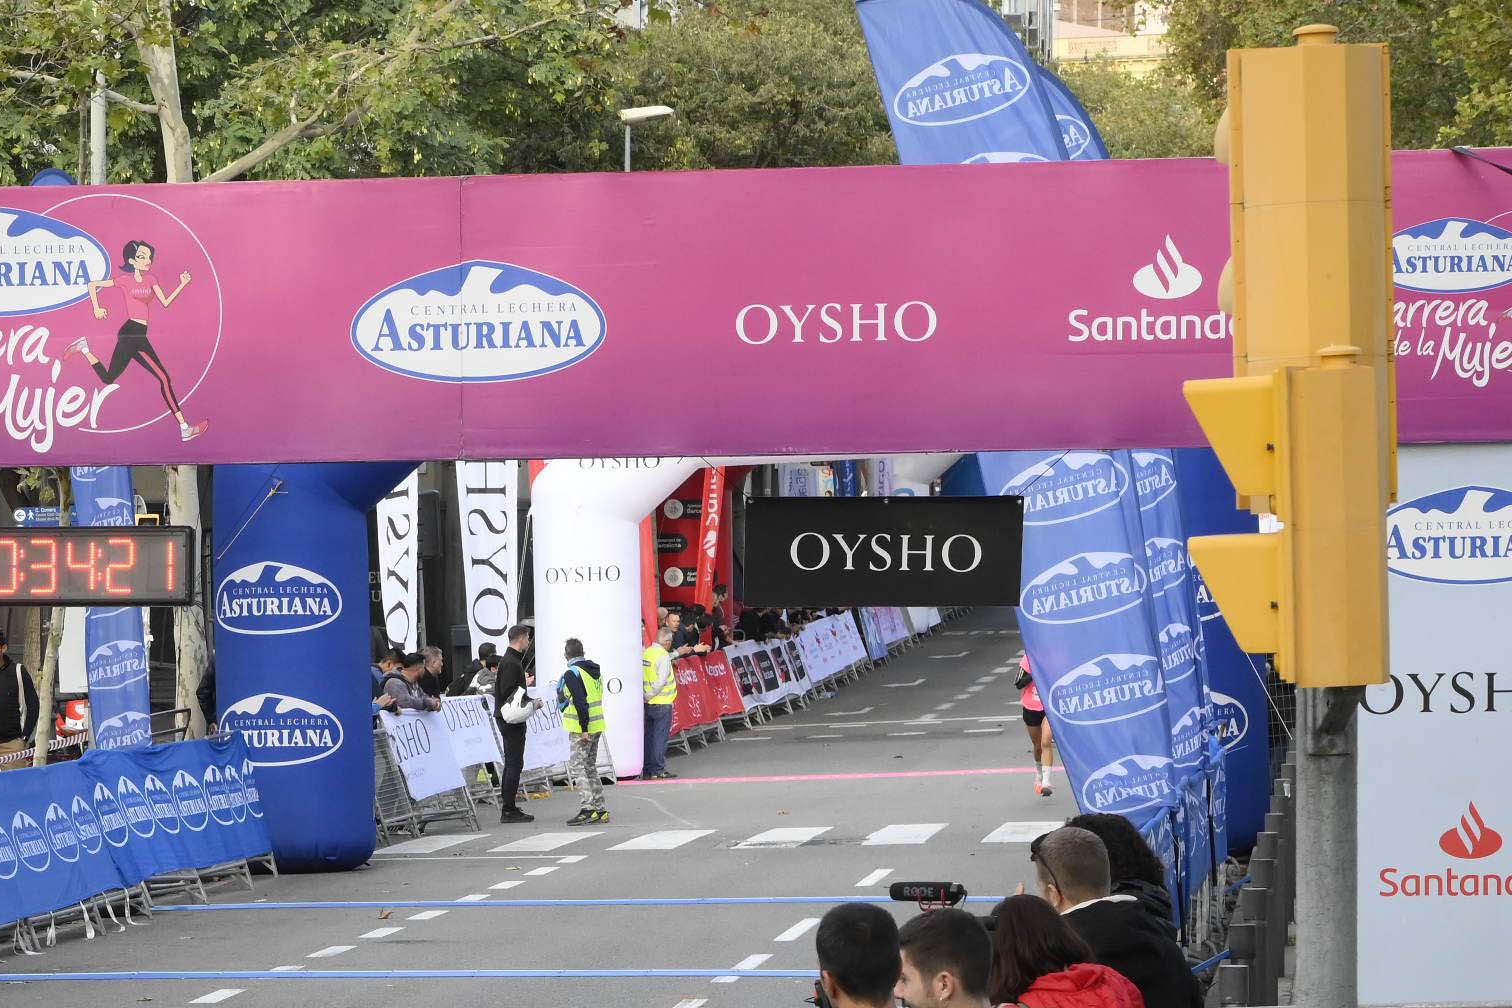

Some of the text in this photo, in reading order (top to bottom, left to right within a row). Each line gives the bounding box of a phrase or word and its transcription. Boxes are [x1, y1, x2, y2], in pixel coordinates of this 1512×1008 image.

[13, 243, 86, 255] LECHERA
[1407, 243, 1459, 252] CENTRAL
[410, 301, 578, 317] CENTRAL LECHERA
[1393, 298, 1489, 328] arrera
[370, 307, 587, 353] ASTURIANA
[735, 300, 938, 345] OYSHO
[1416, 327, 1435, 356] la
[1430, 322, 1512, 388] Muje
[1414, 521, 1482, 531] CENTRAL
[789, 532, 983, 573] OYSHO
[545, 564, 621, 584] OYSHO
[233, 586, 329, 596] CENTRAL LECHERA
[219, 591, 333, 619] ASTURIANA
[234, 718, 329, 727] CENTRAL LECHERA
